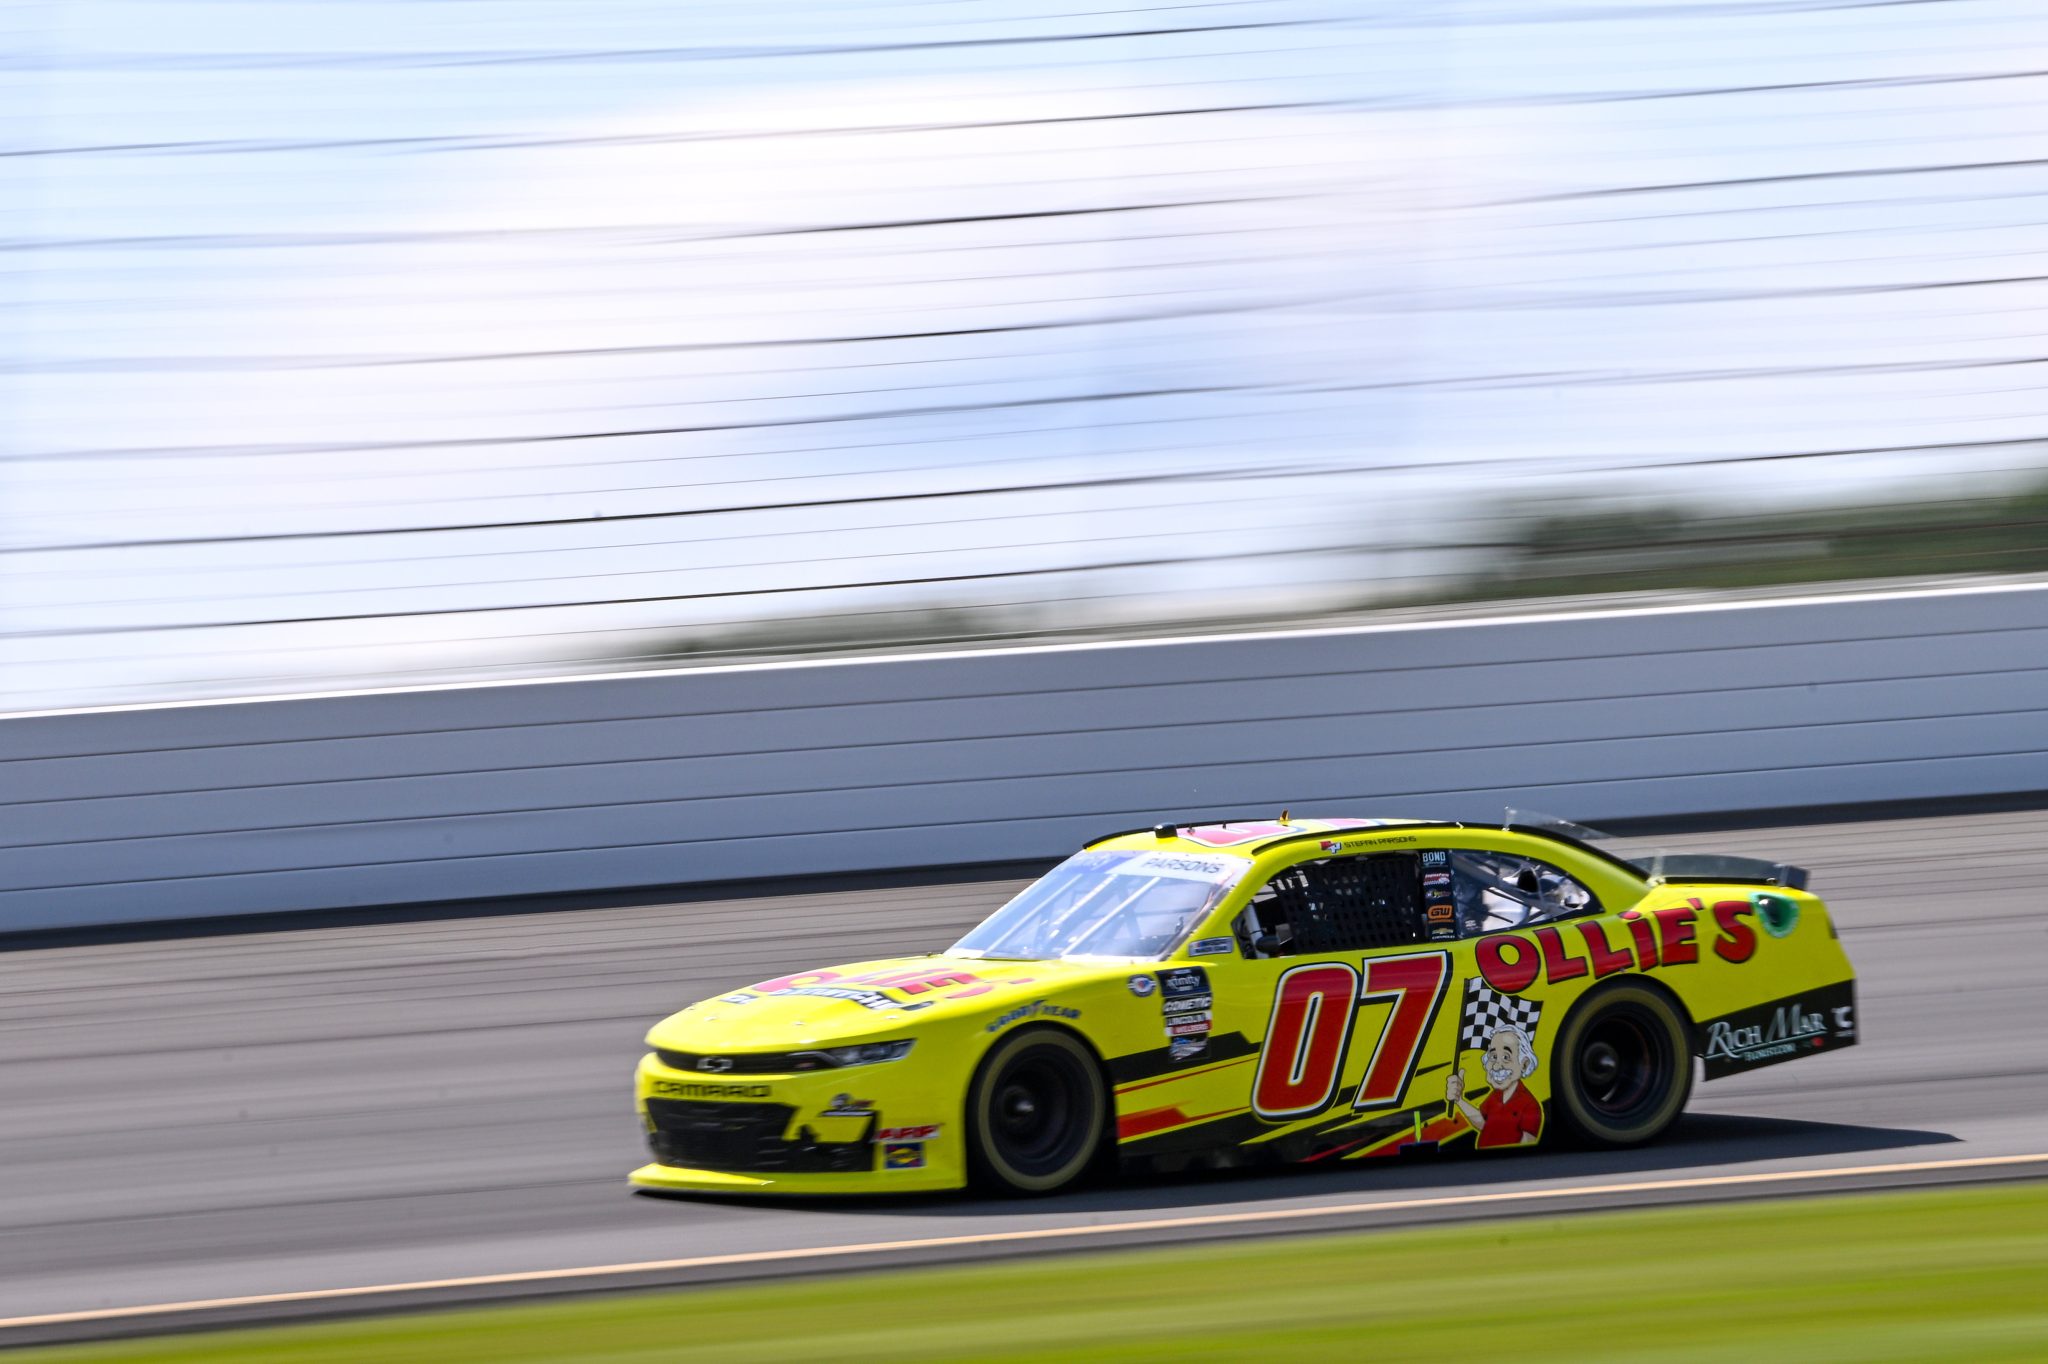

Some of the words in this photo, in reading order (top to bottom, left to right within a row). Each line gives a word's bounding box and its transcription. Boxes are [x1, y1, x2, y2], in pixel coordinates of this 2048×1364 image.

[1141, 858, 1225, 874] PARSONS
[1422, 852, 1446, 862] BOND
[1475, 898, 1756, 994] OLLIE'S
[1252, 949, 1453, 1122] 07
[654, 1080, 771, 1098] CAMARO
